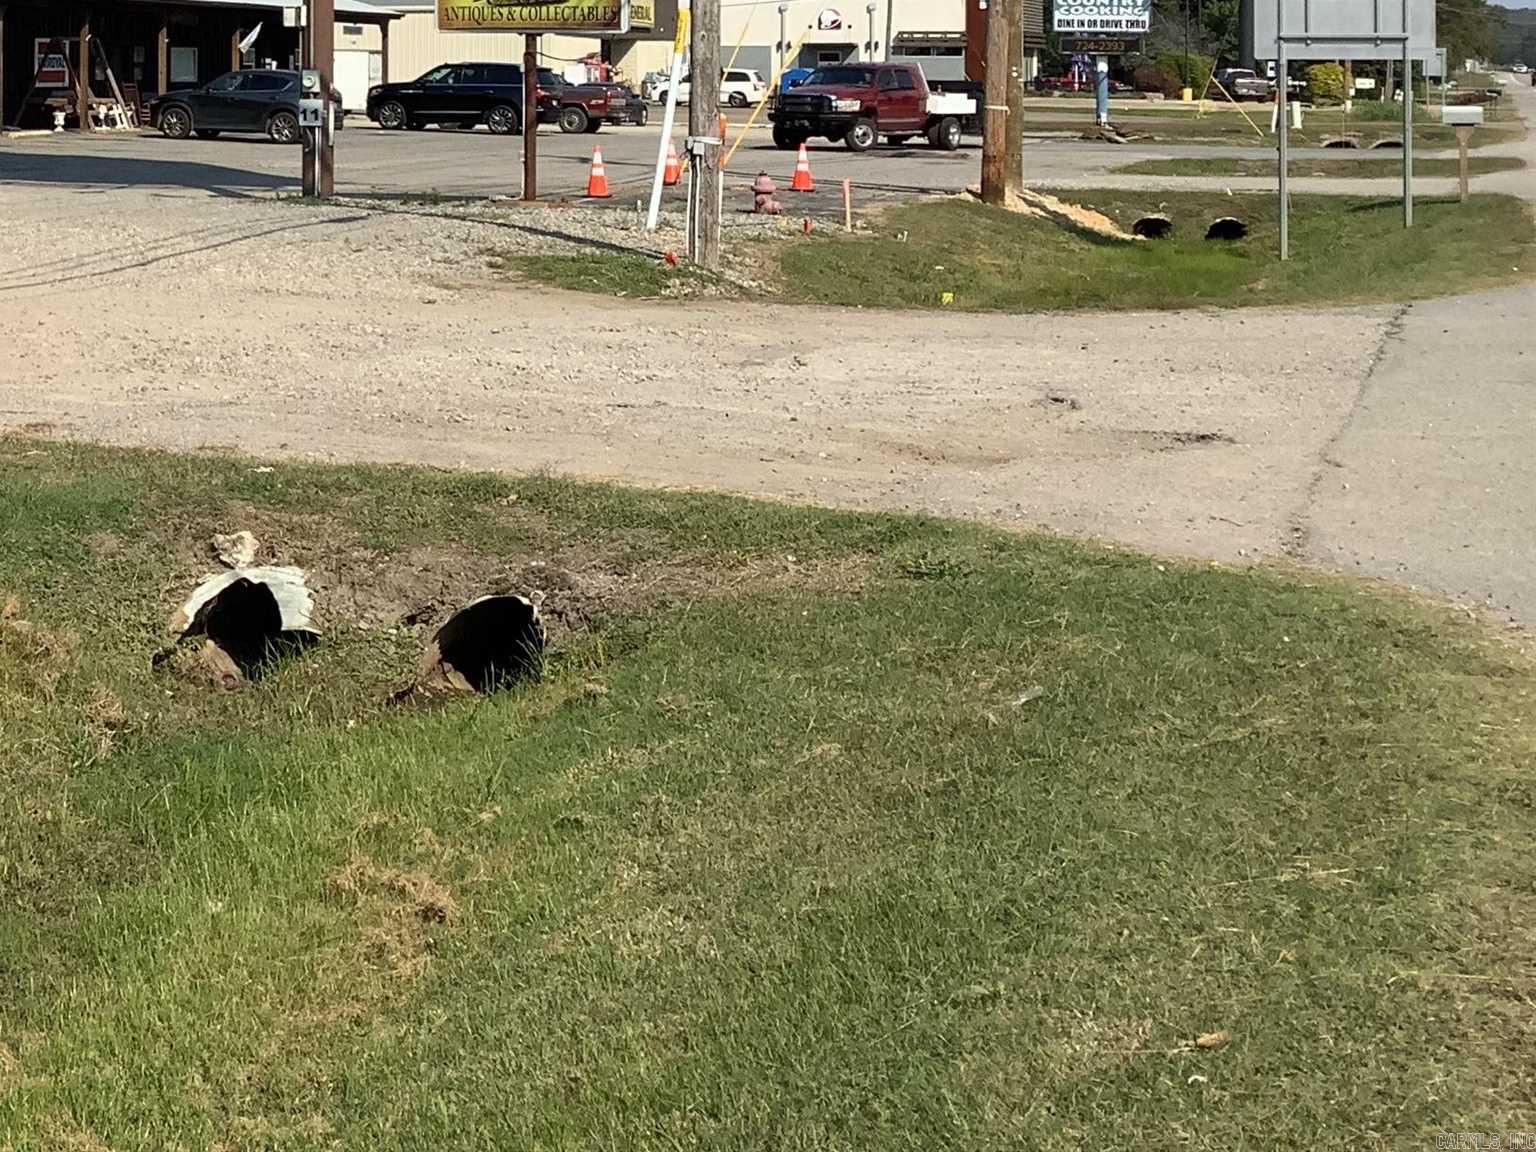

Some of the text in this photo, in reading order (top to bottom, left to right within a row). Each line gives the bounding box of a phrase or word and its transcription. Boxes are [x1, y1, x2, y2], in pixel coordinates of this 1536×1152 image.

[443, 5, 617, 26] ANTIQUES & COLLECTABLES
[1059, 6, 1146, 16] COOKING
[1057, 19, 1075, 29] DINE
[1077, 19, 1085, 29] IN
[1087, 19, 1098, 29] OR
[1100, 19, 1123, 29] DRIVE
[300, 108, 319, 121] 11
